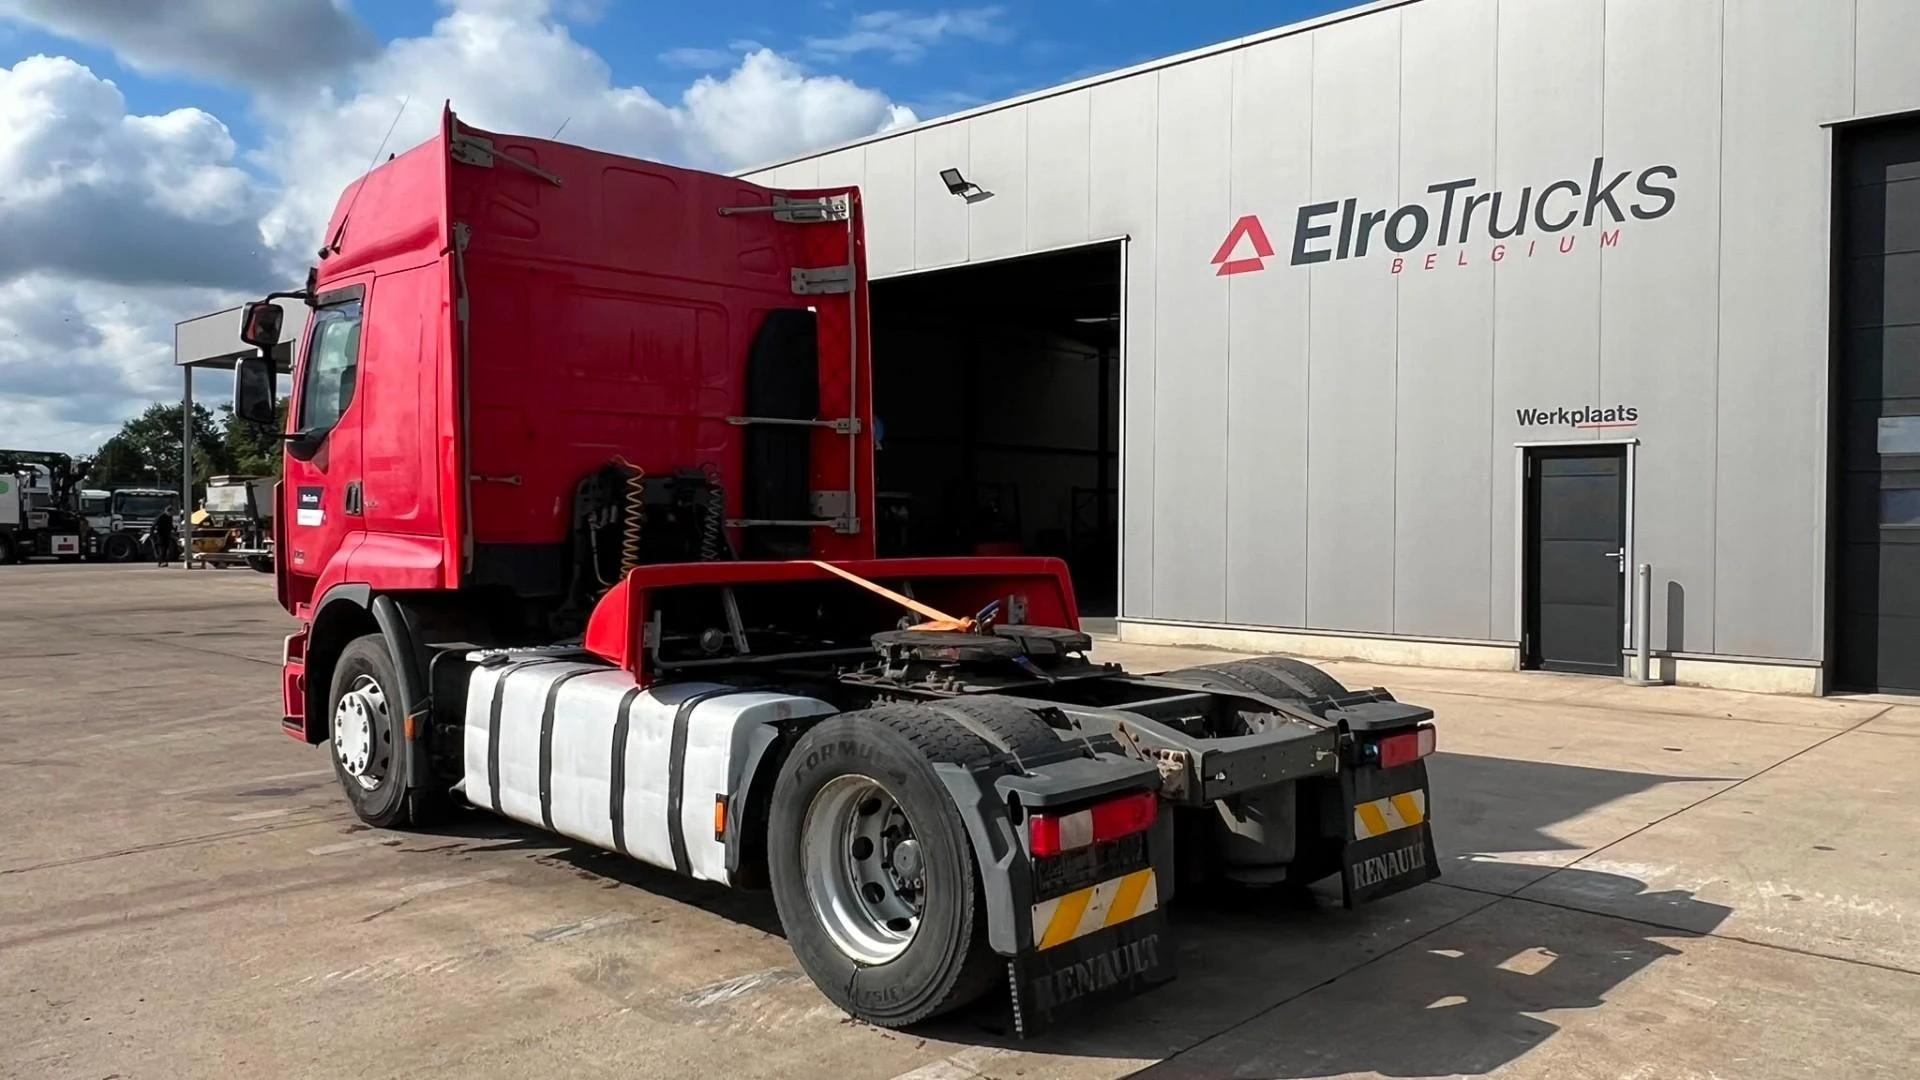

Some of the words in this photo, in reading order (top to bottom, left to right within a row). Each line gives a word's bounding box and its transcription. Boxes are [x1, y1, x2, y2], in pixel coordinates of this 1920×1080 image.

[1290, 157, 1678, 266] ElroTrucks
[1391, 229, 1620, 274] BELGIUM
[1516, 404, 1639, 428] Werkplaats
[1352, 842, 1426, 890] RENAULT
